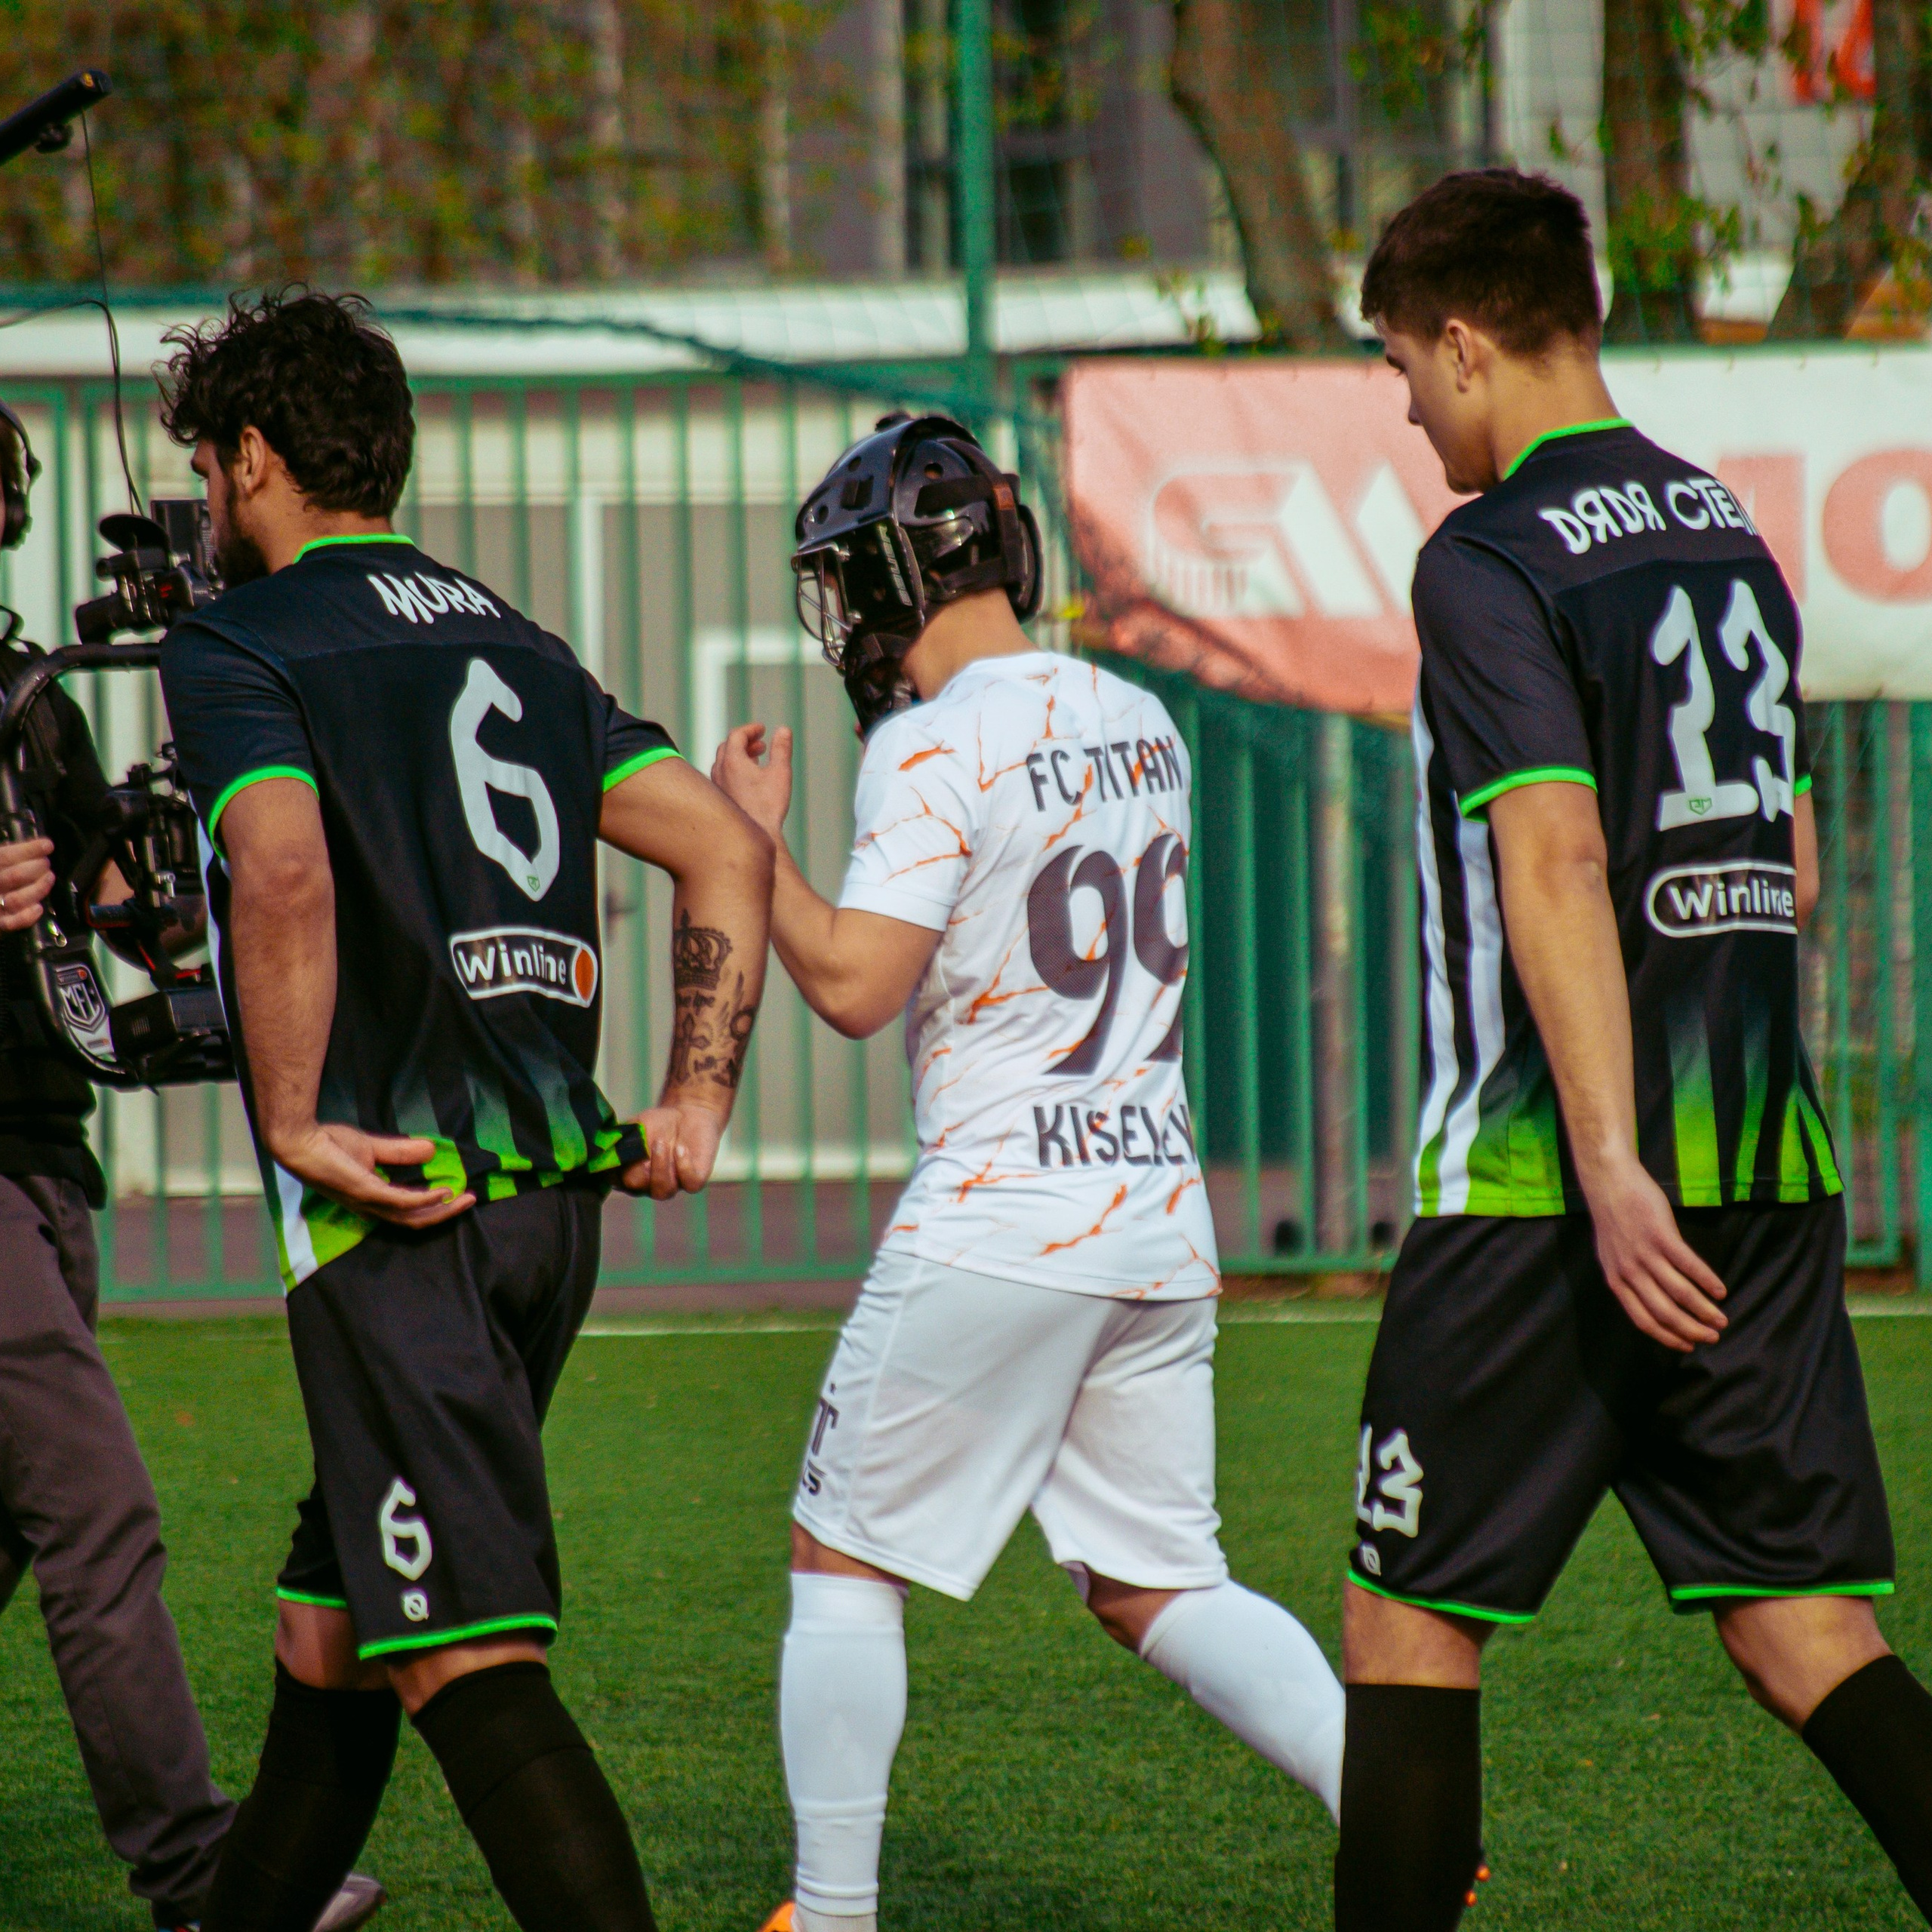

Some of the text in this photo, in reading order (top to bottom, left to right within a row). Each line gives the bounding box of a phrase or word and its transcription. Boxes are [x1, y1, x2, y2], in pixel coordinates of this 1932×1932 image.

[368, 574, 500, 624] MURA
[1654, 579, 1795, 831] 13
[451, 658, 560, 902] 6
[1026, 736, 1183, 812] FC TITAN
[1669, 877, 1795, 920] Winline
[458, 943, 568, 983] Winline
[1028, 833, 1189, 1075] 99
[380, 1479, 432, 1581] 6
